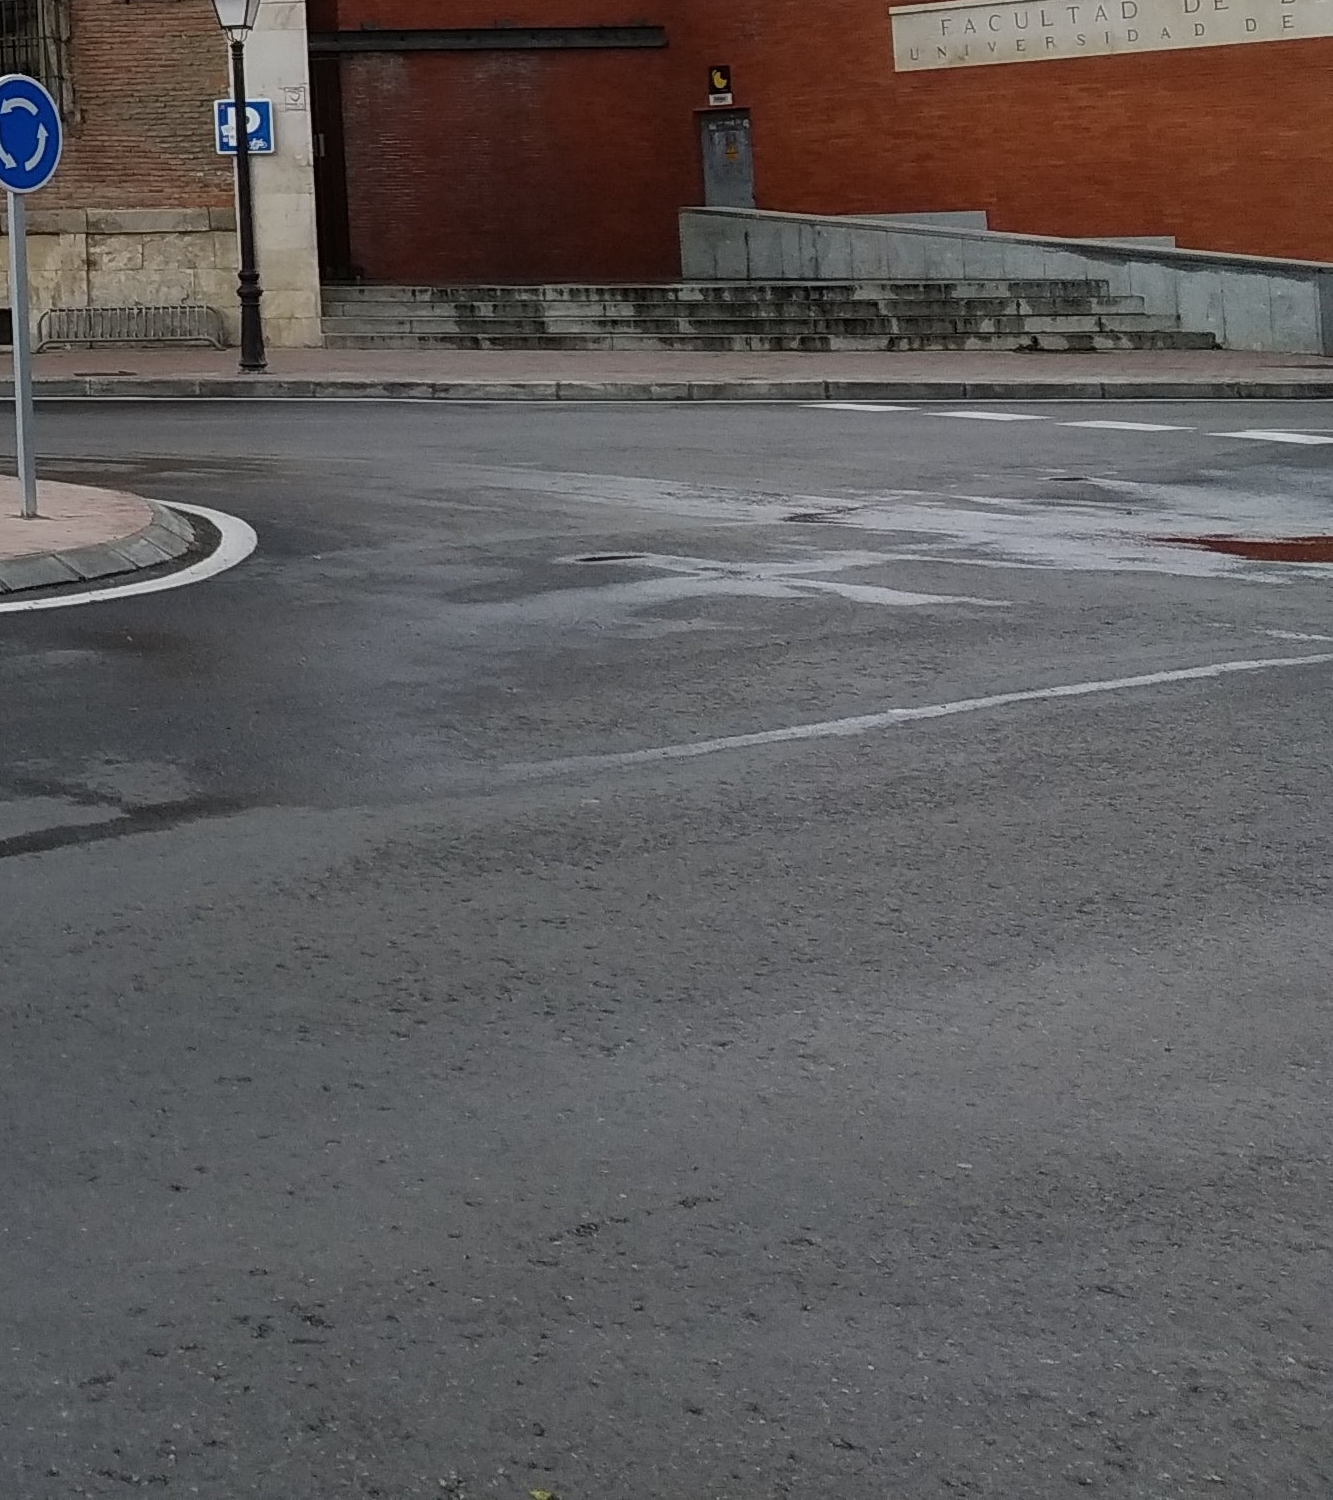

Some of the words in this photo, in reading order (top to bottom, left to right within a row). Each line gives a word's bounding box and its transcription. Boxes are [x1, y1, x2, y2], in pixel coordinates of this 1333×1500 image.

[909, 22, 1206, 62] UNIVERSIDAD
[1244, 14, 1296, 33] DE
[940, 0, 1139, 37] FACULTAD
